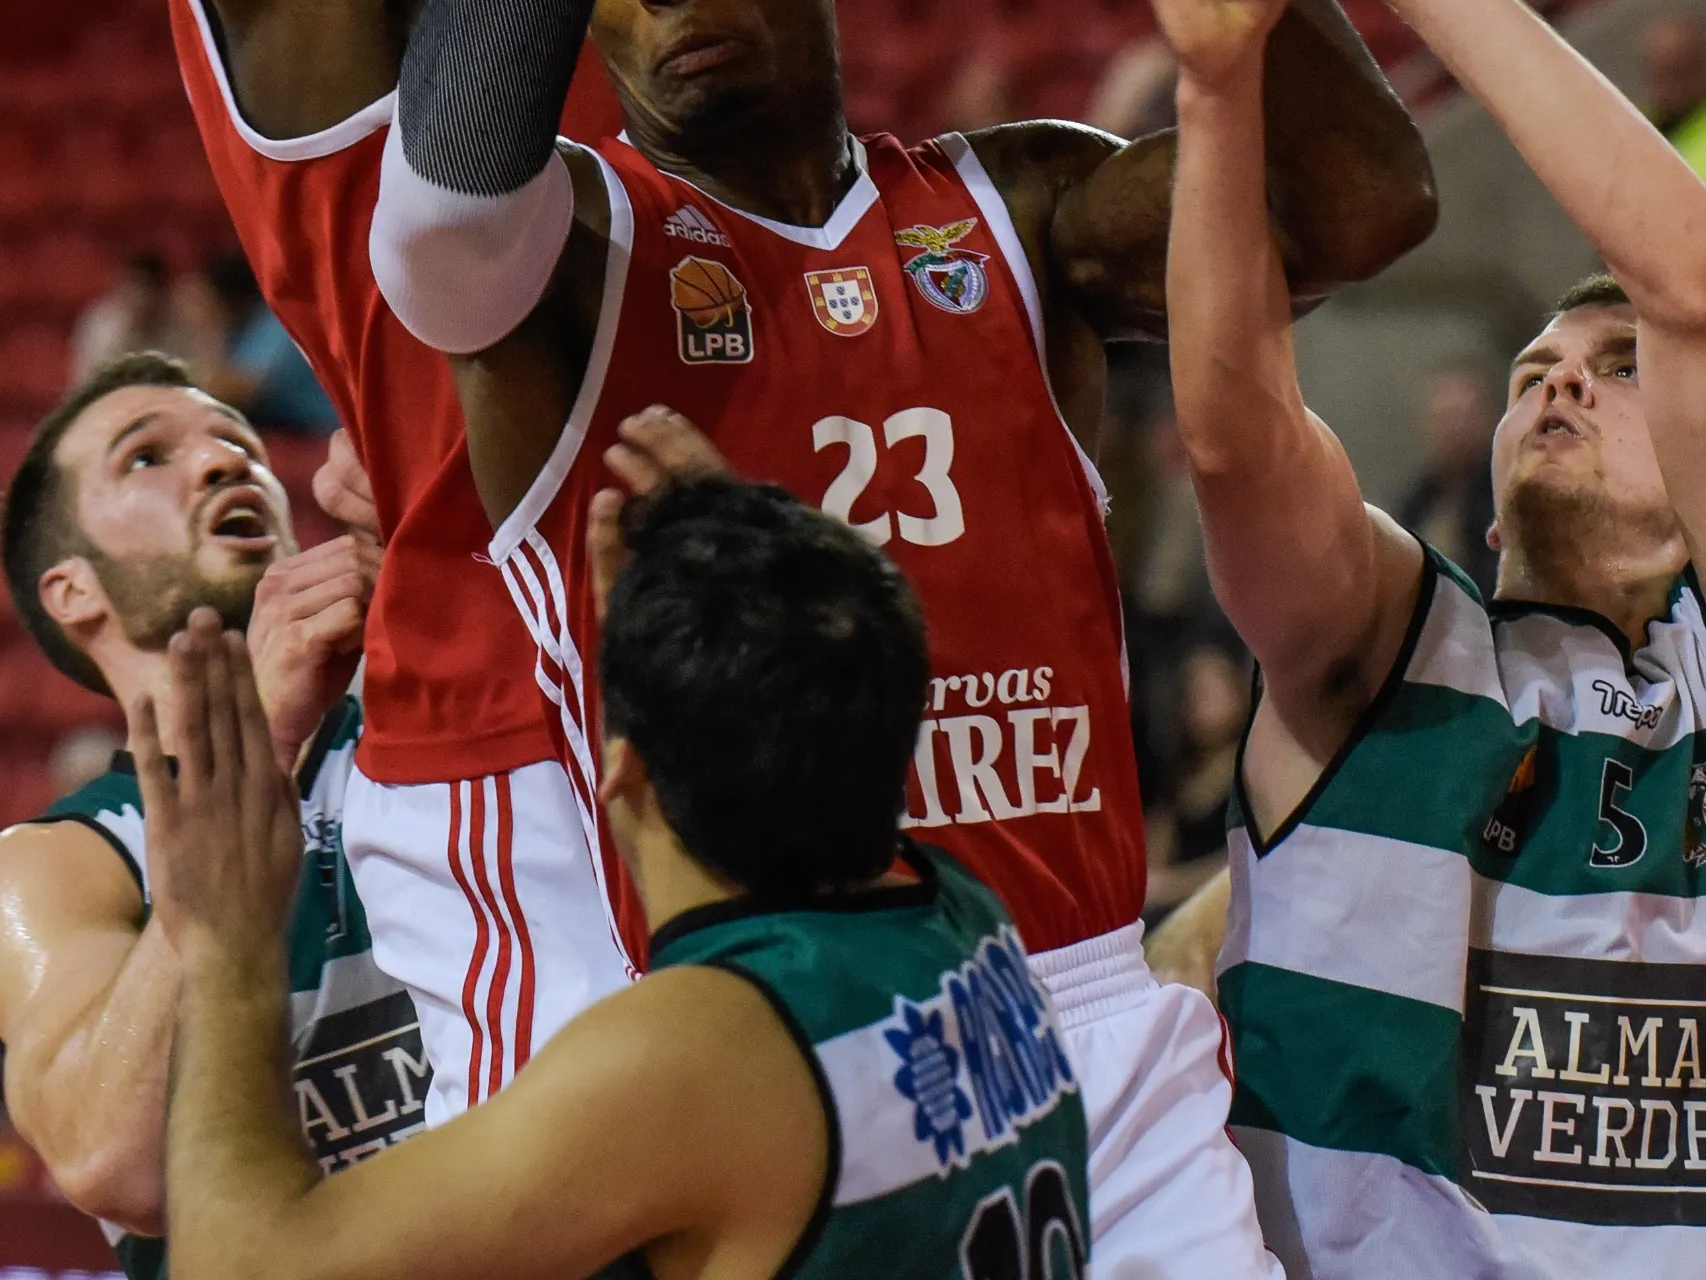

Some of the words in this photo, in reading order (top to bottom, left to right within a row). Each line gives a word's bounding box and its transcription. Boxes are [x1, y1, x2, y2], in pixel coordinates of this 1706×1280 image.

[663, 222, 730, 247] adidas
[687, 333, 743, 358] LPB
[812, 406, 965, 547] 23
[924, 666, 1053, 711] rvas
[896, 704, 1101, 829] IREZ
[1589, 757, 1648, 868] 5
